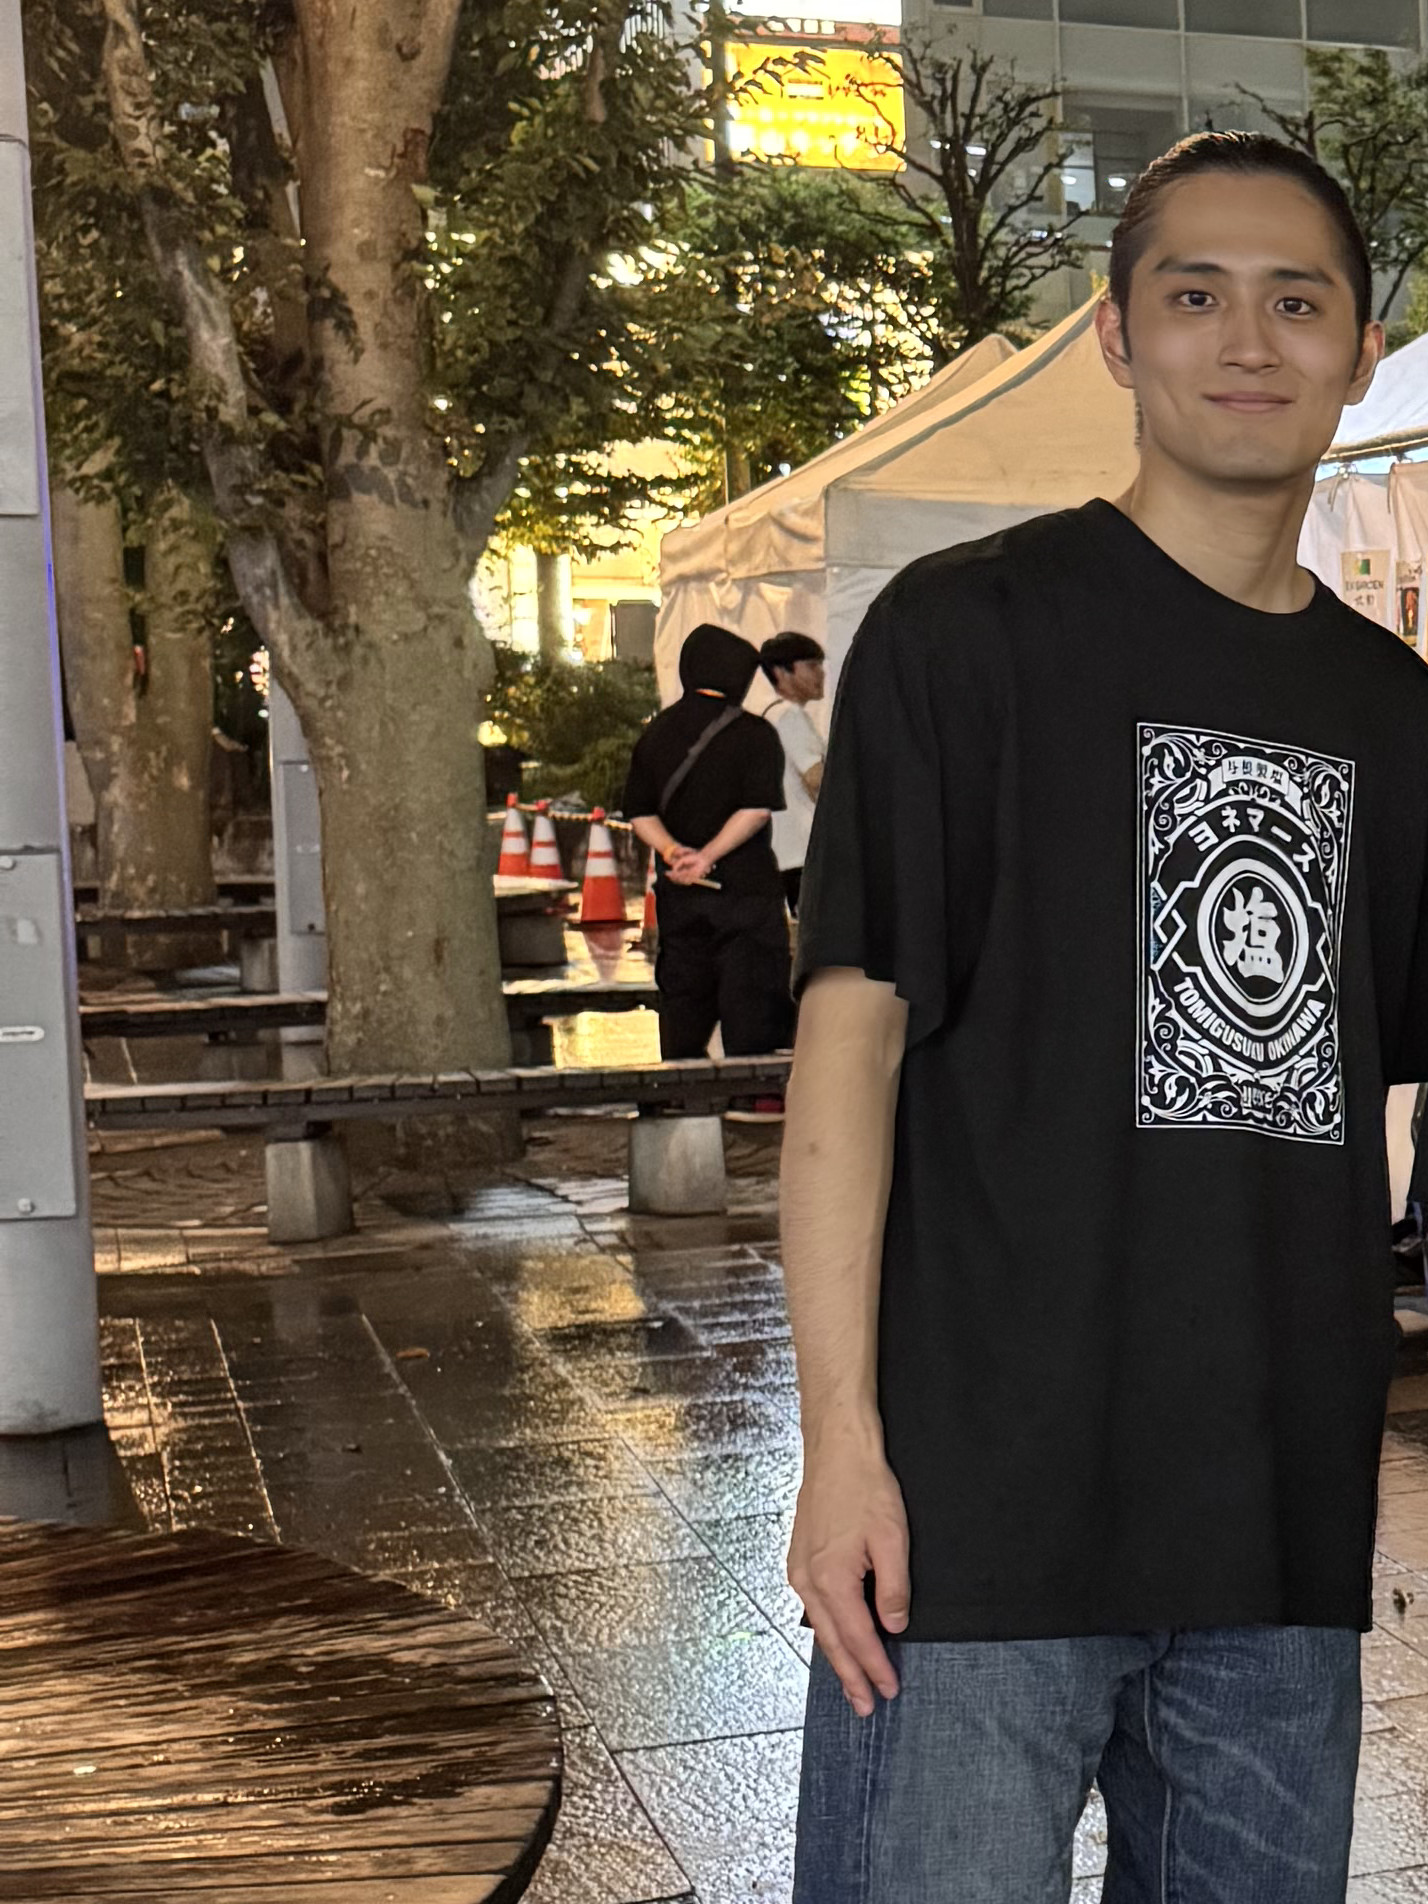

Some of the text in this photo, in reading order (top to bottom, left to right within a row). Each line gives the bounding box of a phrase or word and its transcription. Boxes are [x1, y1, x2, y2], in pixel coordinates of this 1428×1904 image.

[1188, 806, 1316, 873] ヨネマース
[1222, 886, 1285, 984] 塩
[1268, 999, 1326, 1061] OKINAWA
